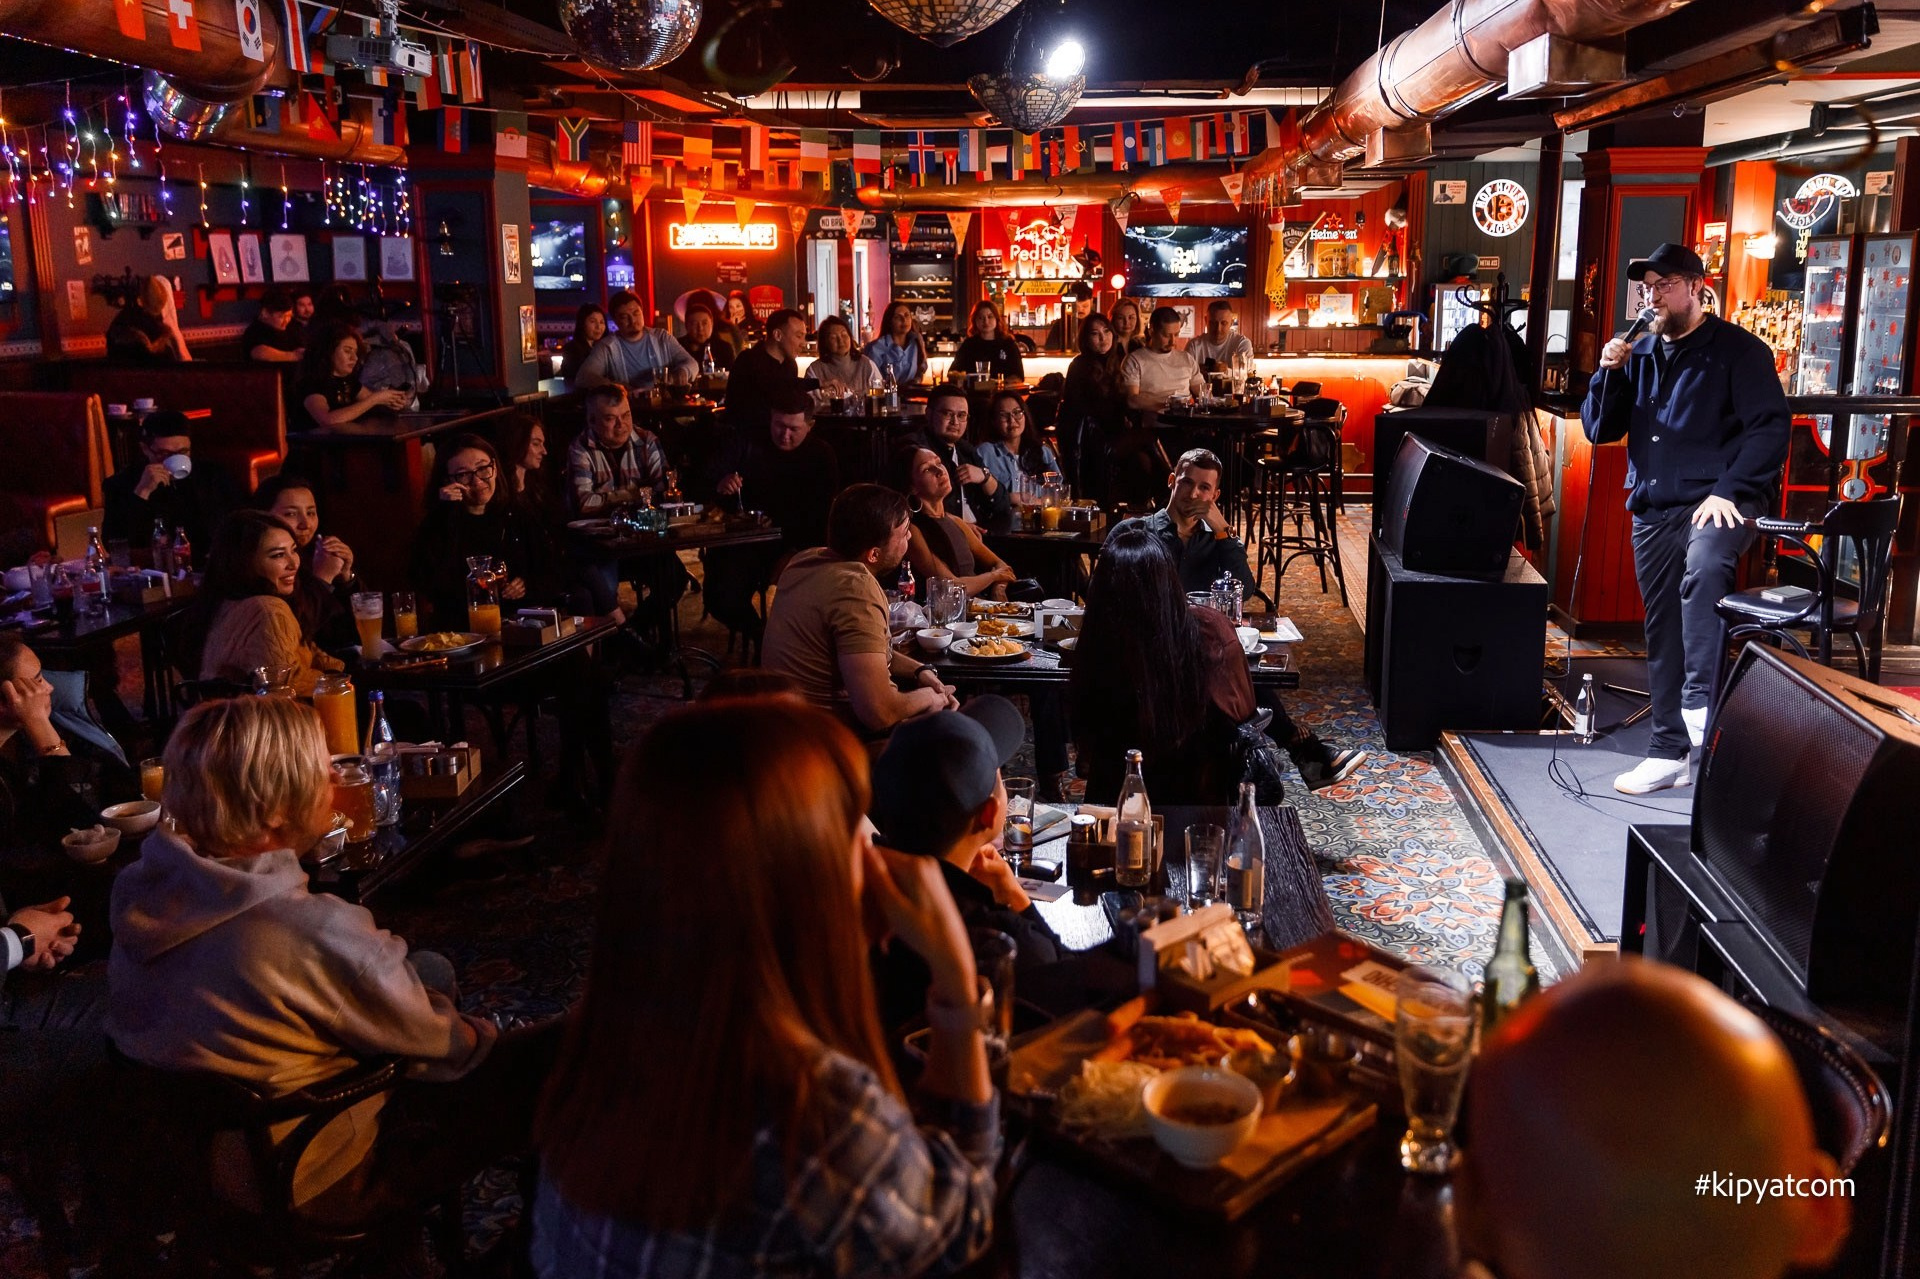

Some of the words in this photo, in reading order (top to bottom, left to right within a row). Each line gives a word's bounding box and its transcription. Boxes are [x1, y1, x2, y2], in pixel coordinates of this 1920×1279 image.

[1475, 185, 1496, 209] HOP
[1496, 183, 1527, 208] HOUSE
[1483, 216, 1524, 234] LAGER
[1310, 229, 1358, 240] Heineen
[1010, 244, 1040, 261] Red
[752, 308, 775, 319] PRI
